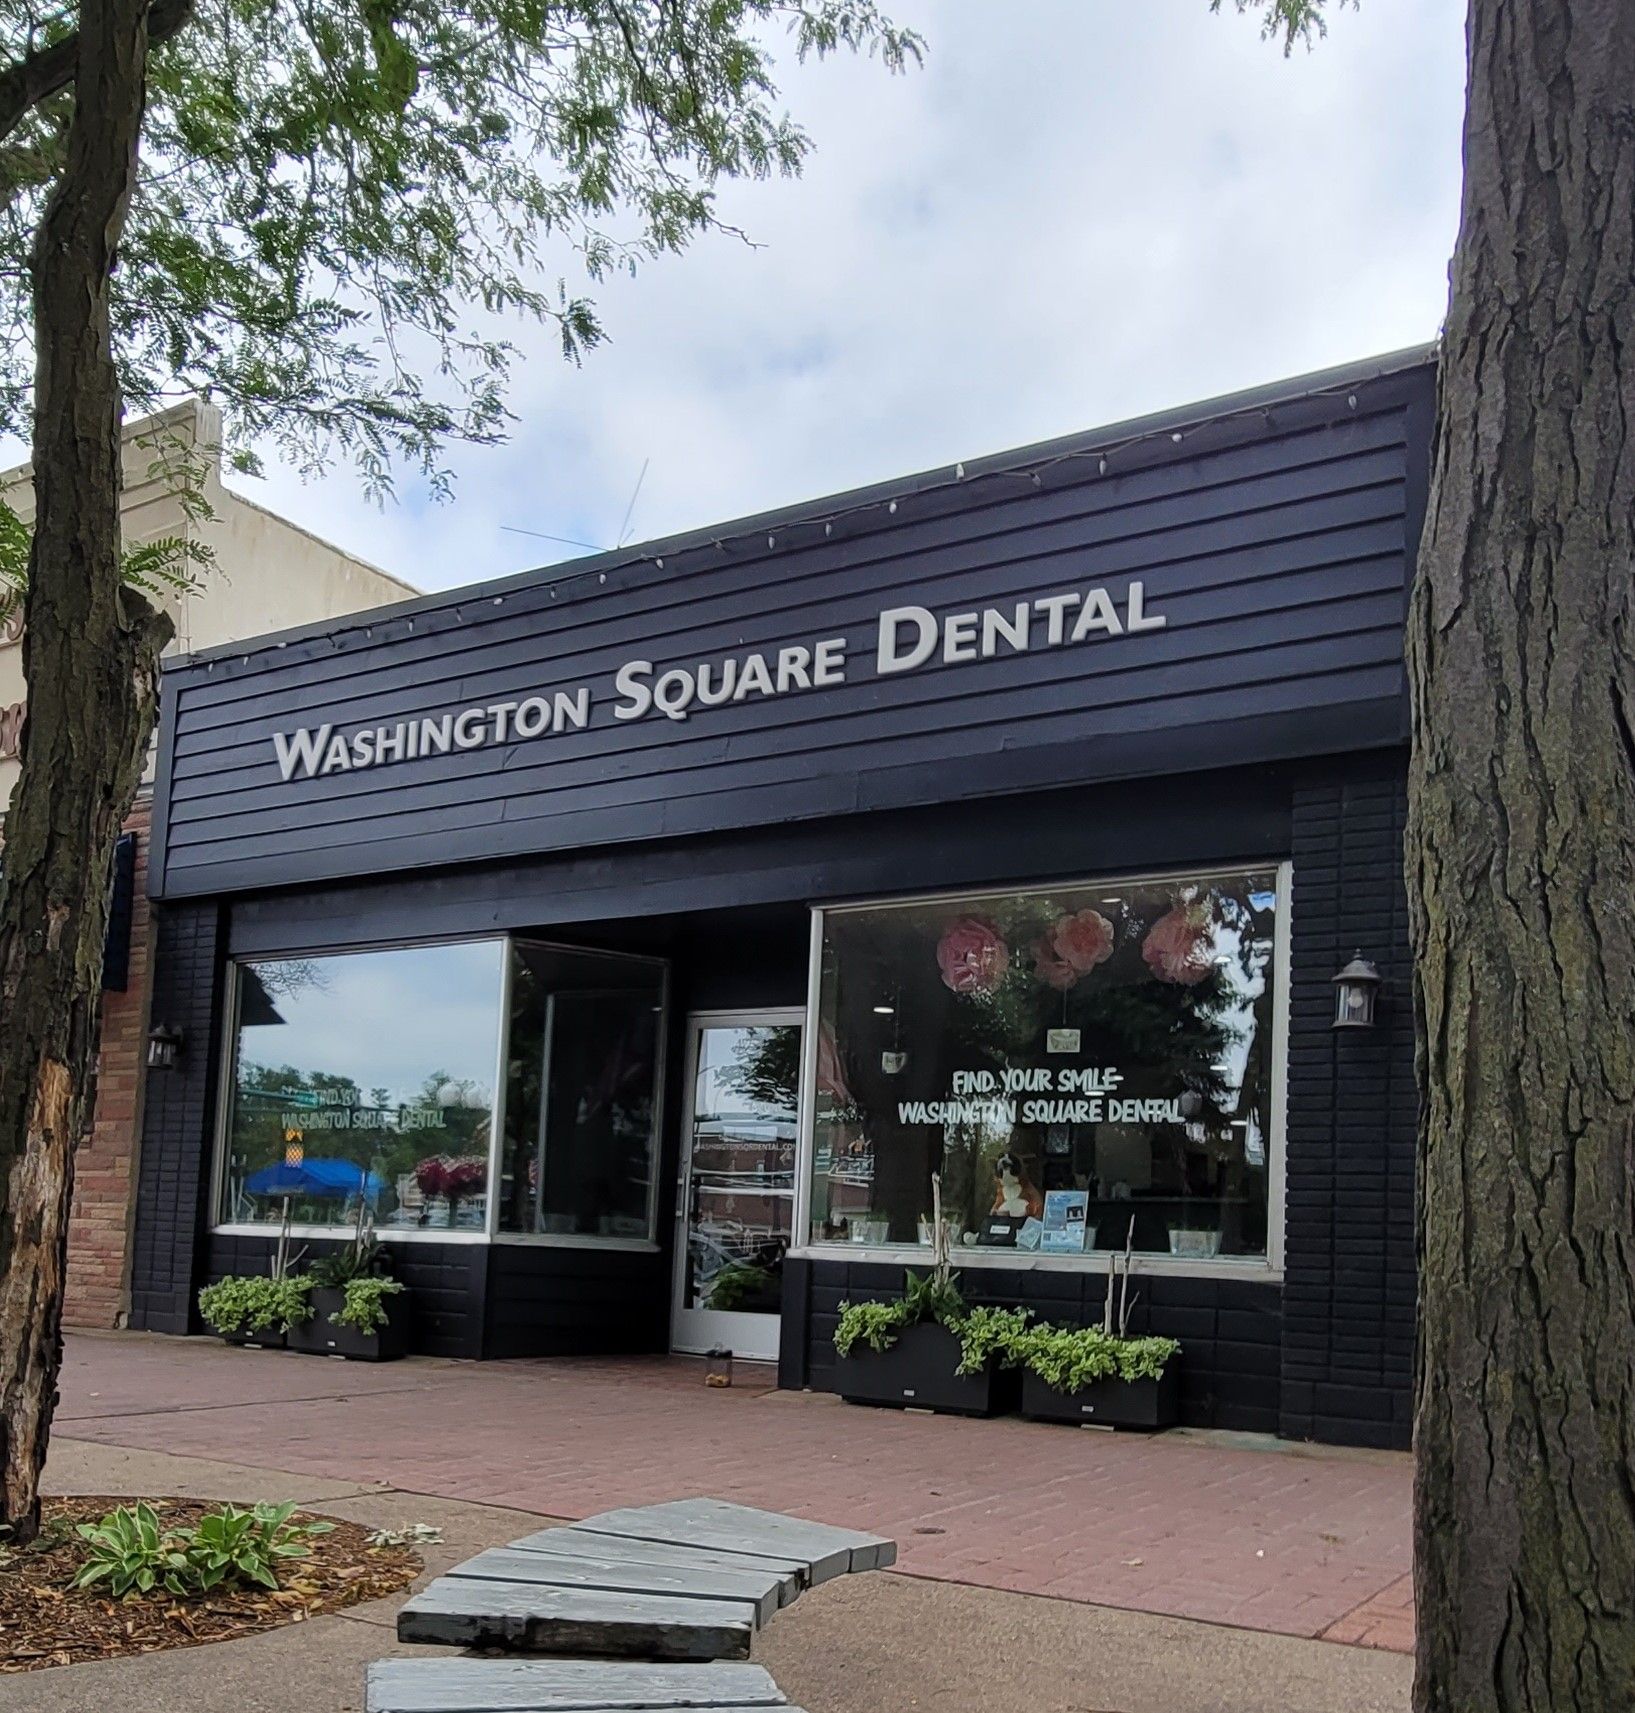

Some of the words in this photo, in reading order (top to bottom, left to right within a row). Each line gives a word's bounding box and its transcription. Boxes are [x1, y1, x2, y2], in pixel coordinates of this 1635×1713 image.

[273, 688, 590, 782] WASHINGTON
[613, 638, 847, 721] SQUARE
[876, 581, 1167, 675] DENTAL
[952, 1070, 995, 1095] FIND
[999, 1068, 1053, 1093] YOUR
[1057, 1067, 1118, 1092] SMILE
[281, 1108, 350, 1130] WASHINGTON
[401, 1108, 447, 1130] DENTAL
[898, 1100, 1017, 1124] WASHINGTON
[1022, 1100, 1103, 1124] SQUARE
[1108, 1099, 1185, 1124] DENTAL
